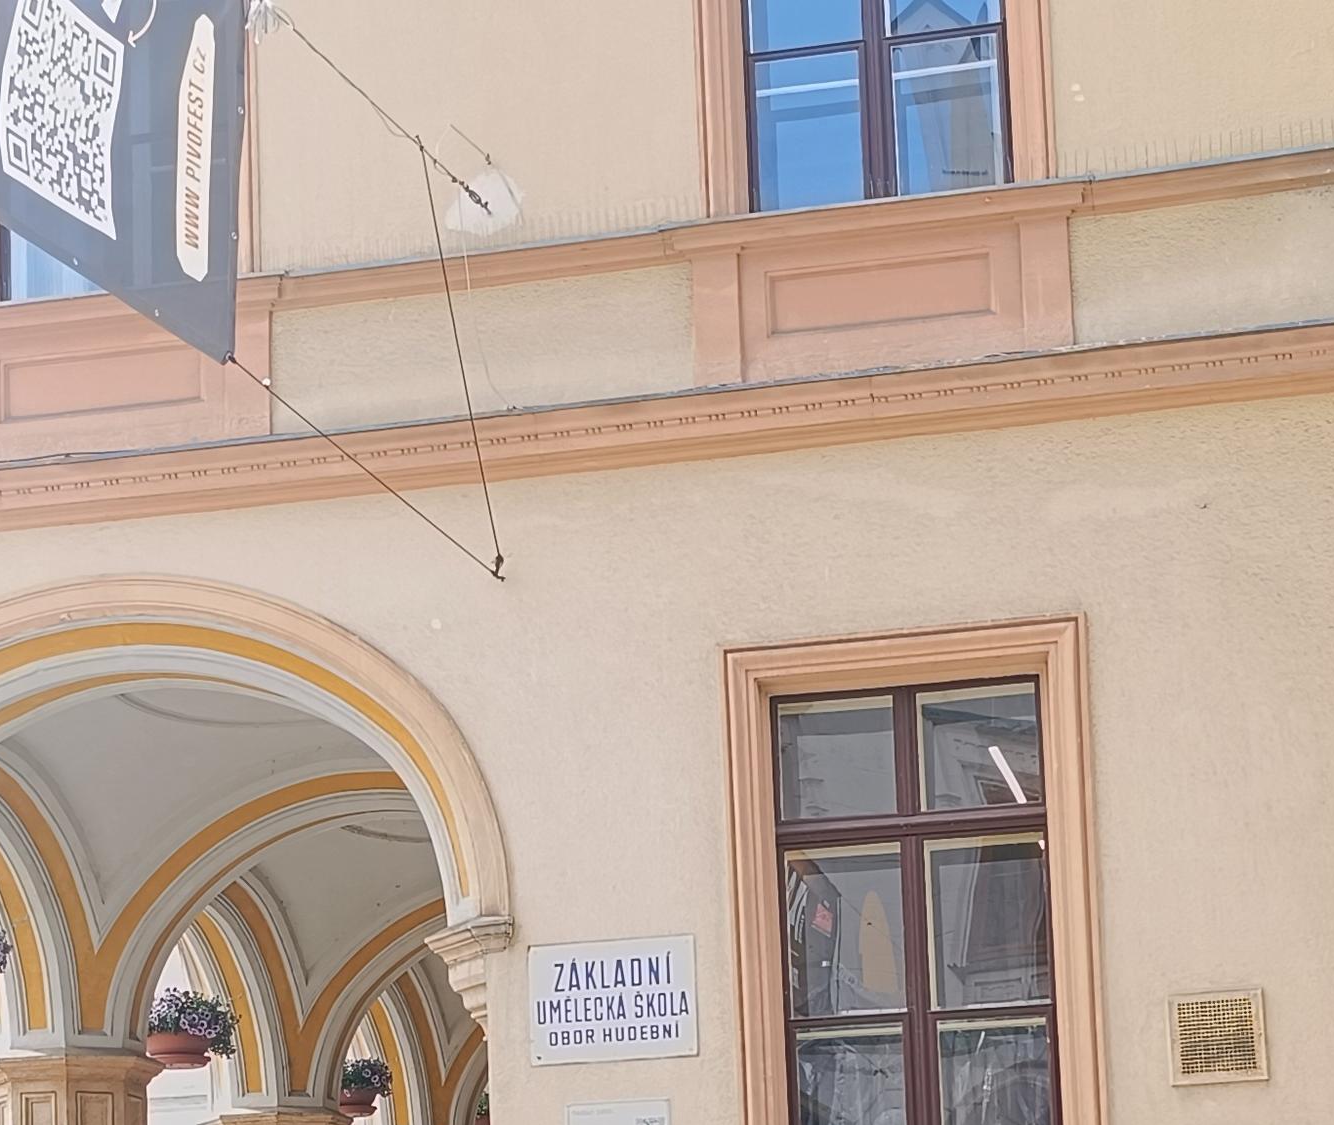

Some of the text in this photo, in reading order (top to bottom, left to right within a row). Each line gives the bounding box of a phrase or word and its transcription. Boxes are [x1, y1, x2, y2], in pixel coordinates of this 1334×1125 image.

[553, 950, 671, 992] ZÁKLADNÍ
[536, 990, 689, 1025] UMĚLECKÁ ŠKOLA
[549, 1020, 680, 1047] OBOR HUDEBNÍ
